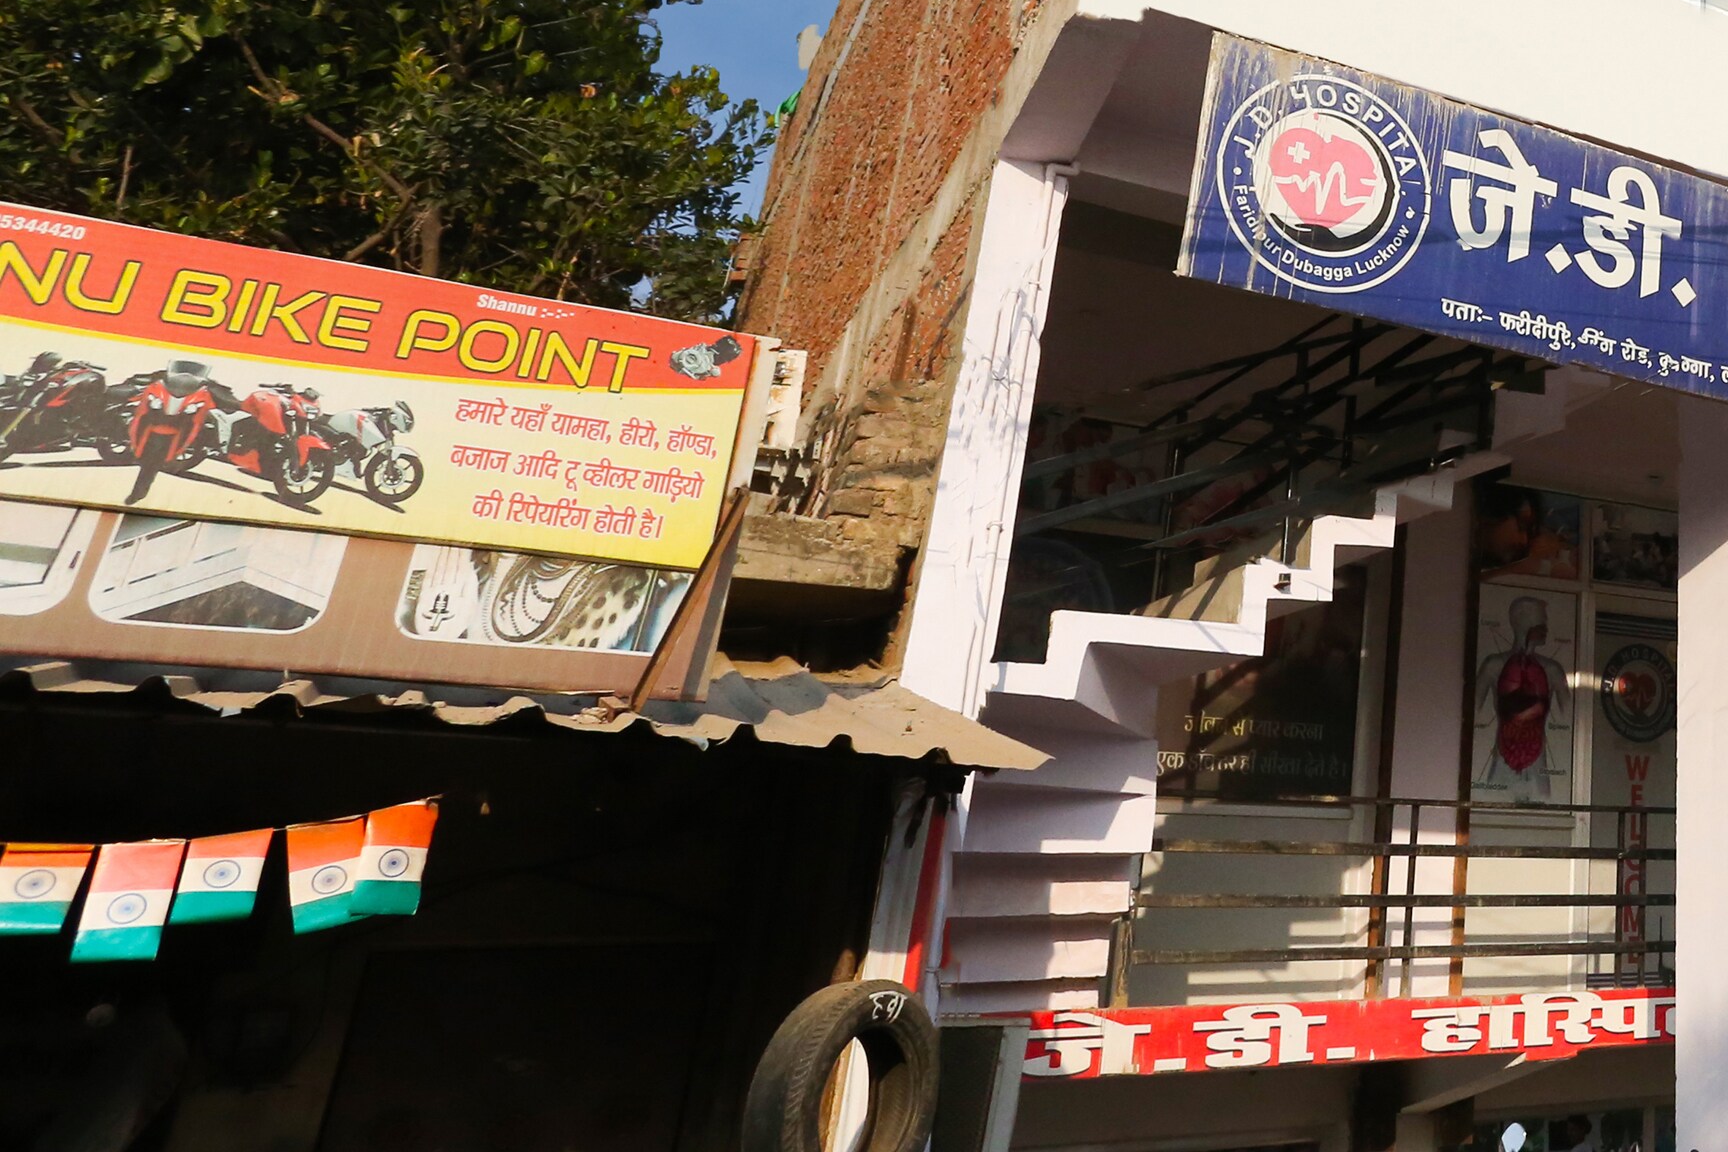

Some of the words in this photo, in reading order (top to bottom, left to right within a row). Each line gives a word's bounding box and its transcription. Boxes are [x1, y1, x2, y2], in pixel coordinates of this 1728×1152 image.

[0, 214, 86, 240] 5344420
[1281, 249, 1353, 281] Dubagga
[1354, 224, 1410, 275] Lucknow
[160, 267, 383, 353] BIKE
[395, 309, 652, 394] POINT
[477, 294, 537, 317] Shannu
[454, 396, 508, 426] हमारे
[510, 402, 552, 432] यहाँ
[550, 412, 612, 445] यामहा,
[618, 416, 660, 451] हीरो,
[666, 424, 718, 460] हॉण्डा,
[450, 444, 512, 473] बजाज
[512, 449, 561, 480] आदि
[564, 459, 581, 492] टू
[582, 456, 641, 490] व्हीलर
[471, 488, 504, 520] की
[505, 491, 593, 531] रिपेयरिंग
[593, 503, 637, 536] होती
[638, 507, 665, 540] है।
[1156, 750, 1186, 777] एक
[1192, 1003, 1358, 1067] डी.
